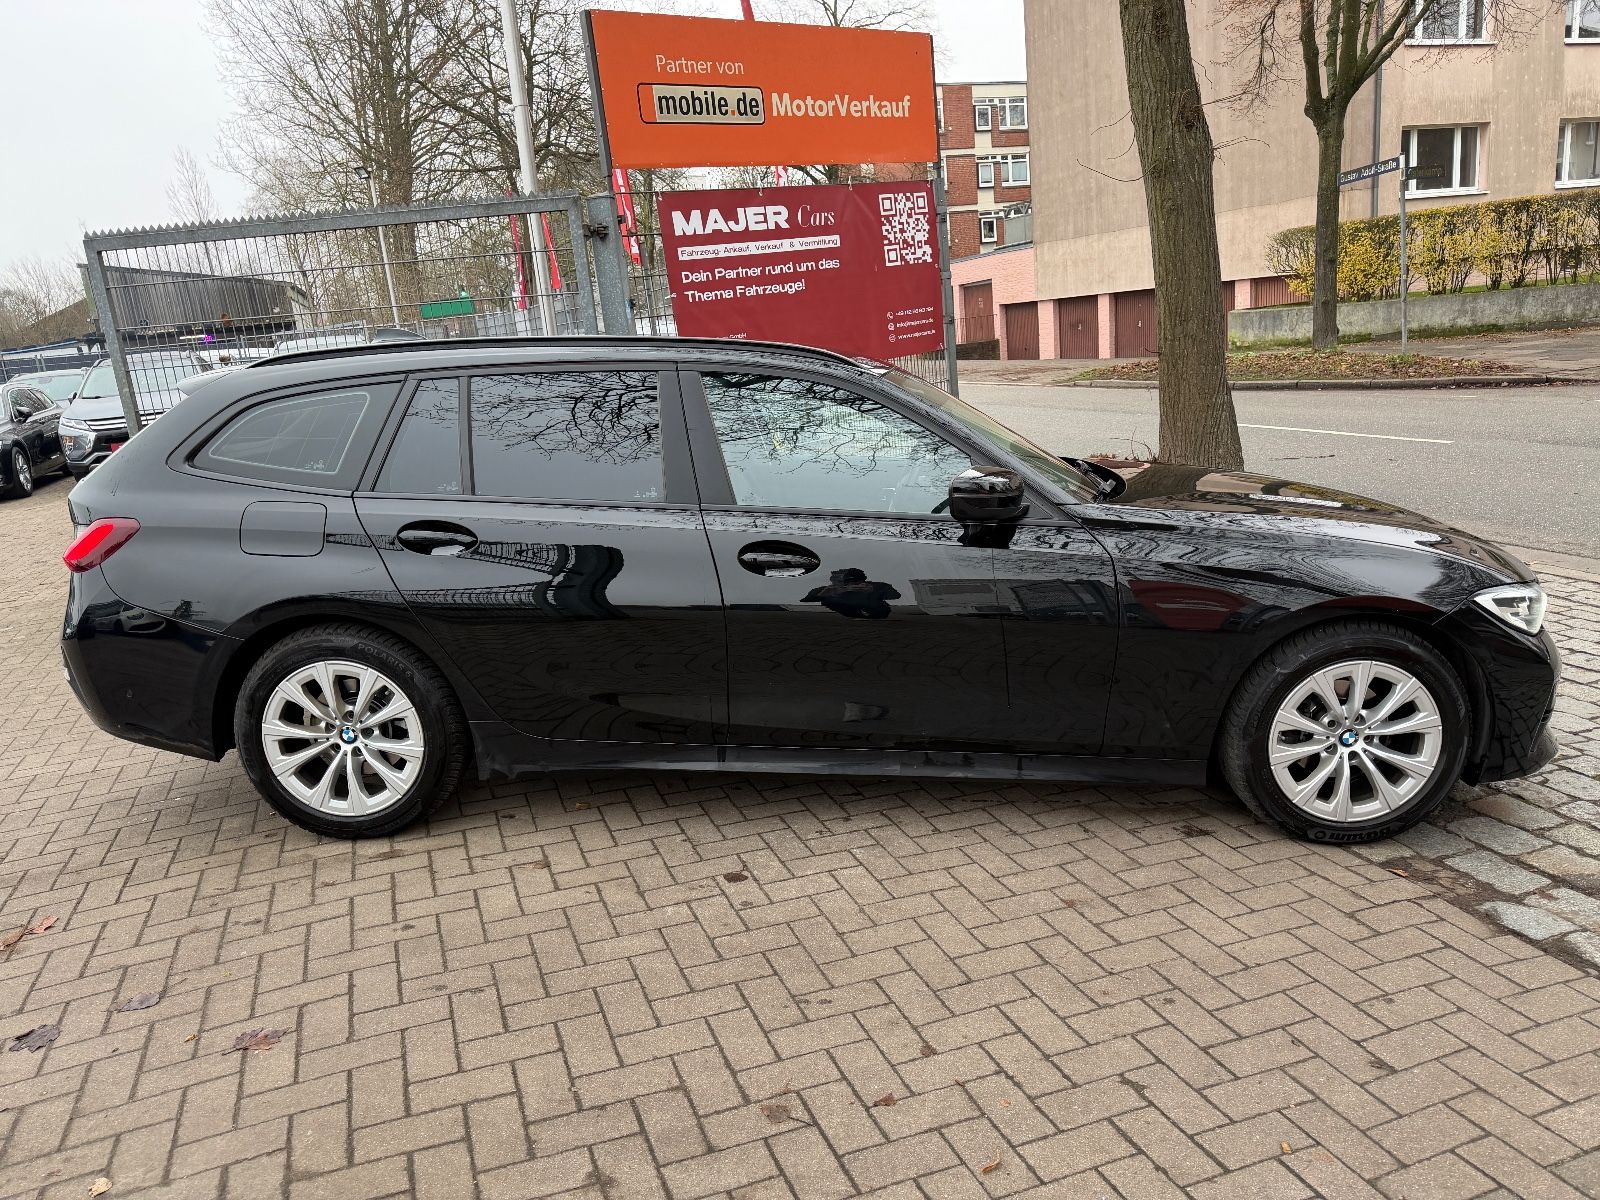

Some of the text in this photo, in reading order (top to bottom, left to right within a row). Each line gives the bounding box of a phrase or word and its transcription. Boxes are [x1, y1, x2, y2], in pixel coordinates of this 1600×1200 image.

[655, 54, 744, 75] Partner von
[657, 90, 760, 117] mobile.de
[771, 92, 911, 118] MotorVerkauf
[671, 205, 835, 236] MAJER Cars
[754, 241, 784, 251] Verkauf
[798, 238, 838, 248] Vermittlung
[681, 257, 840, 284] Dein Partner rund um das
[684, 279, 806, 303] Thema Fahrzeuge!
